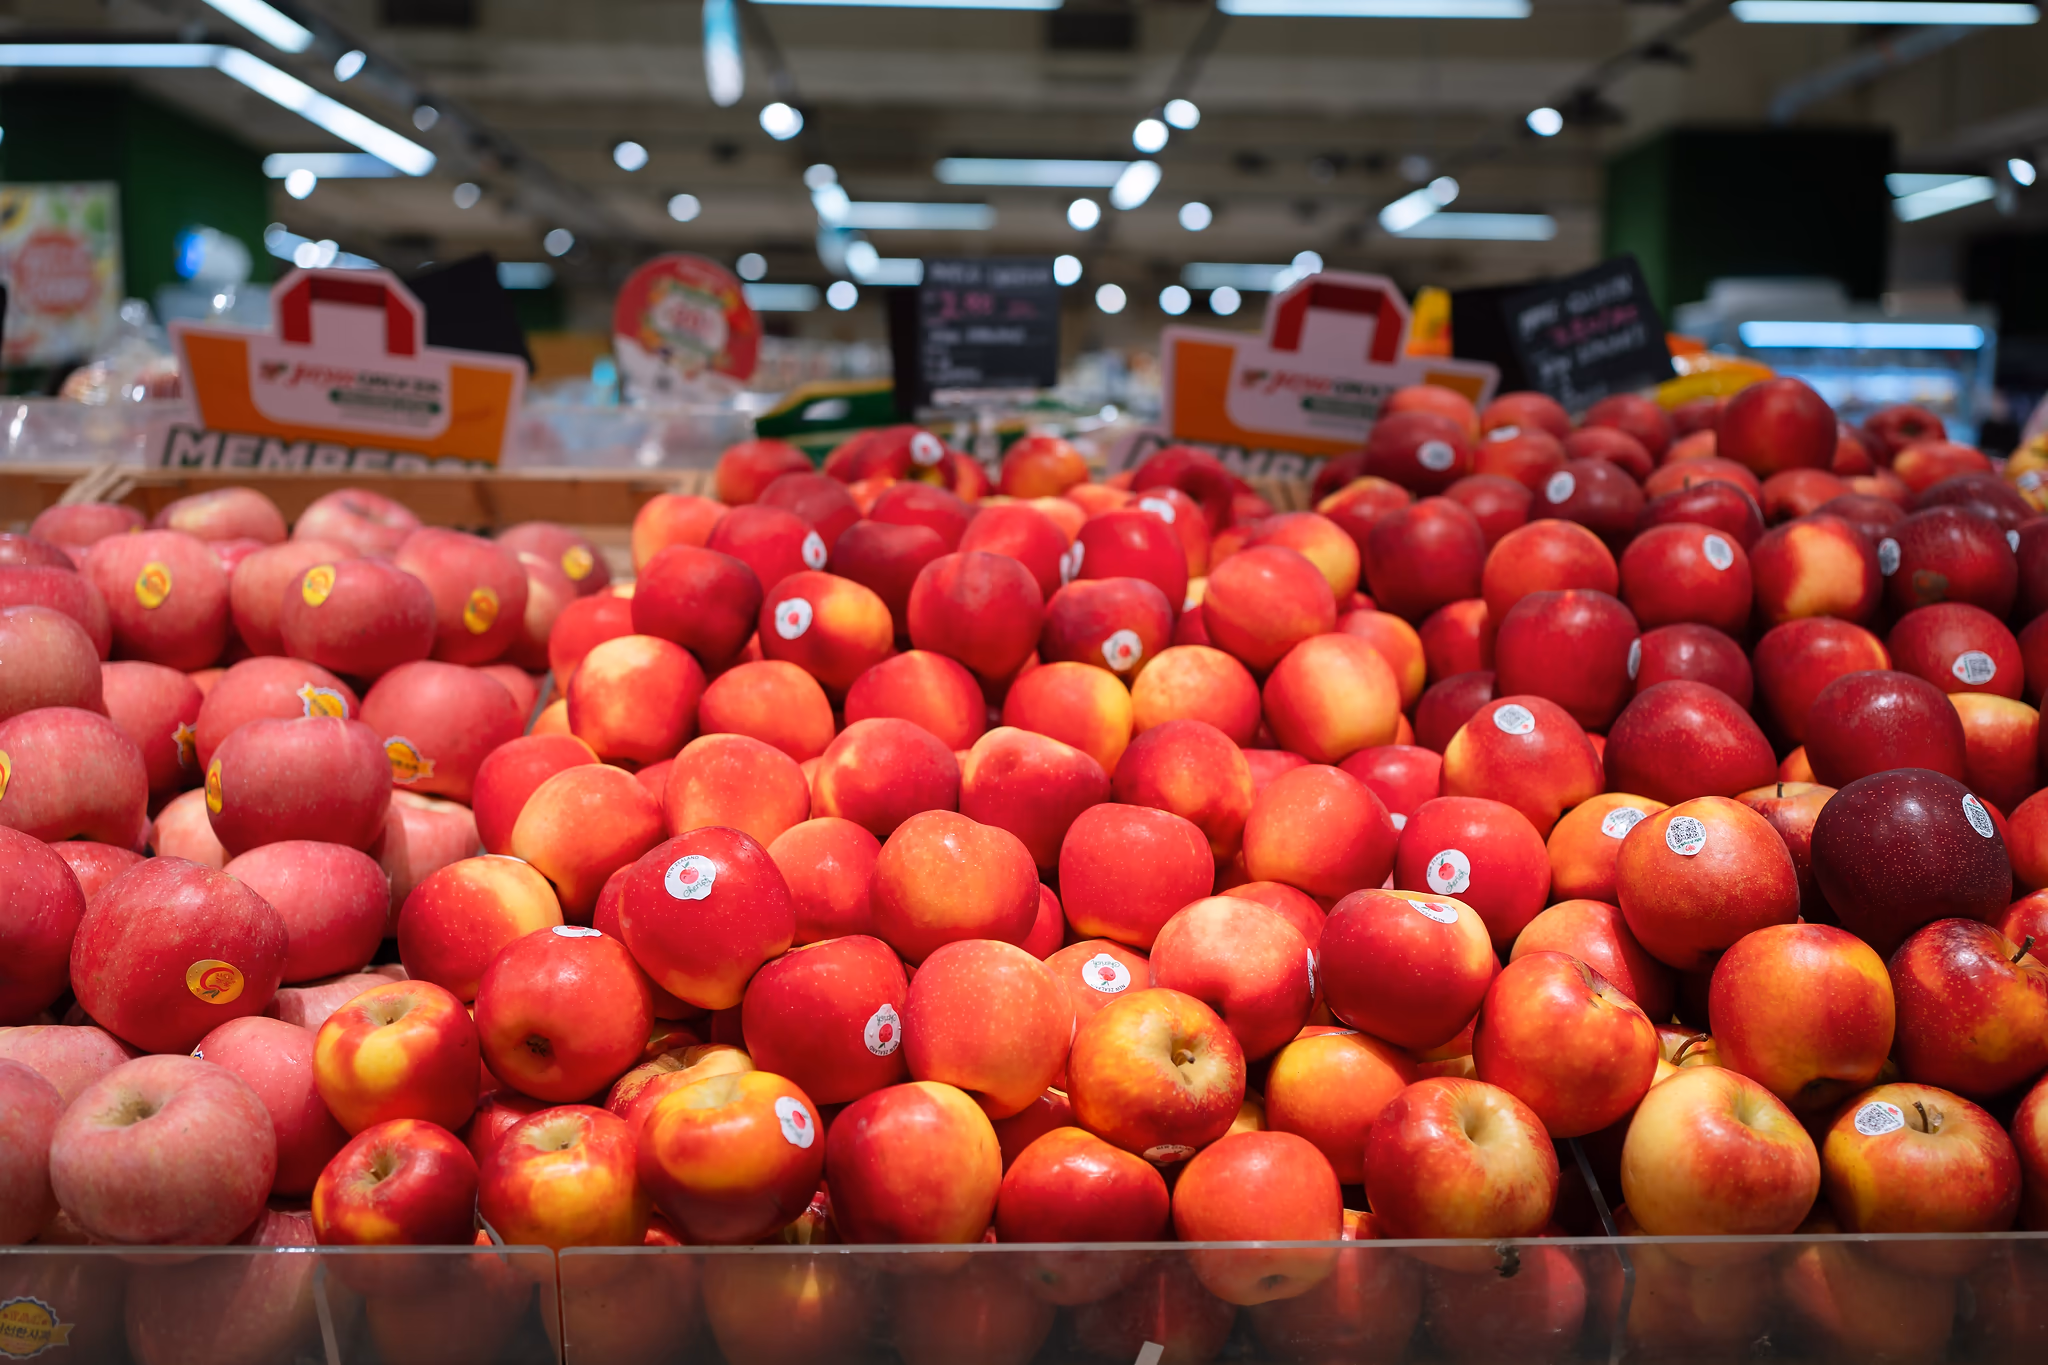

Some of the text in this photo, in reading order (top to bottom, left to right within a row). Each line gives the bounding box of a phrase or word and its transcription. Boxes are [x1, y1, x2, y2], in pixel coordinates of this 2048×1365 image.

[666, 855, 700, 878] NEW ZEALAND
[1115, 983, 1126, 992] NEW
[868, 1040, 899, 1056] NEW ZEALAND
